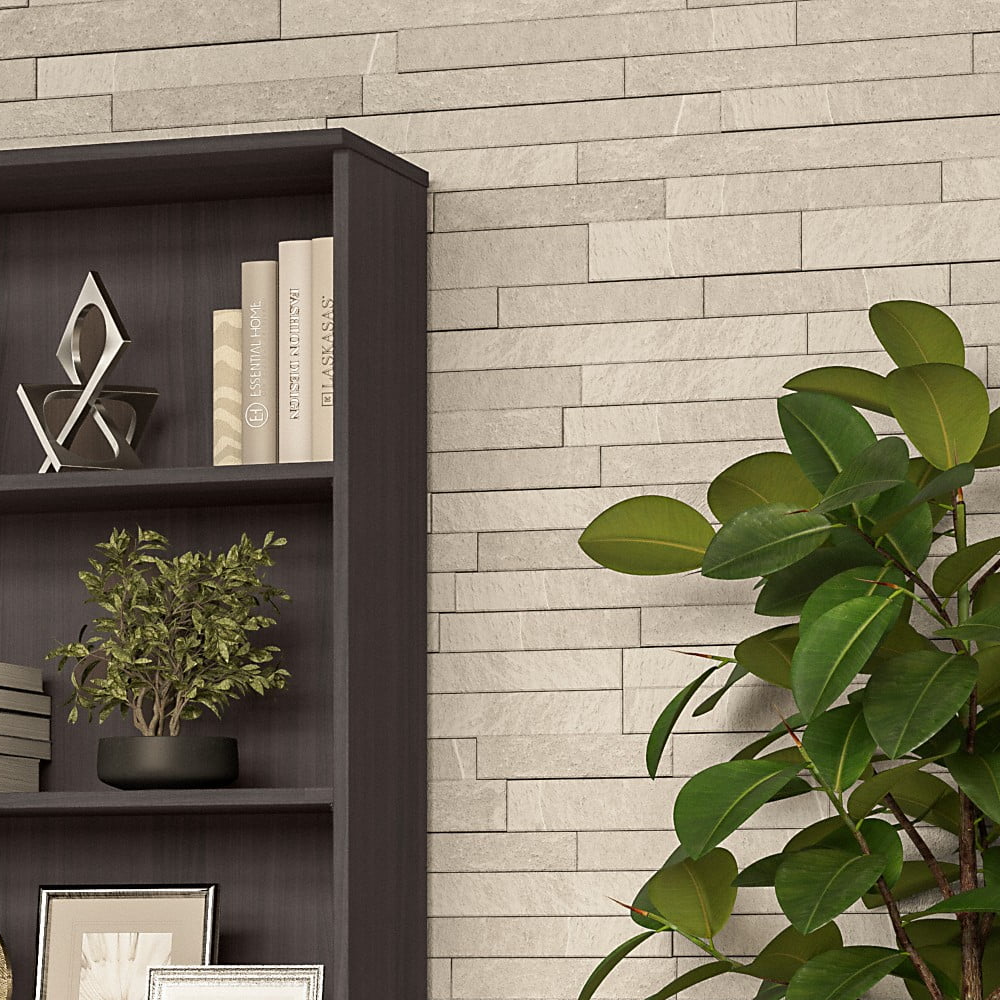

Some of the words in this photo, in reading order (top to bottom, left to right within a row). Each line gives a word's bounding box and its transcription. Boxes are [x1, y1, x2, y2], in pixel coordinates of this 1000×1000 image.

[249, 300, 262, 338] HOME
[289, 288, 300, 357] FASHION
[321, 298, 334, 389] LASKASAS
[249, 341, 262, 397] ESSENTIAL
[289, 360, 300, 420] DESIGN
